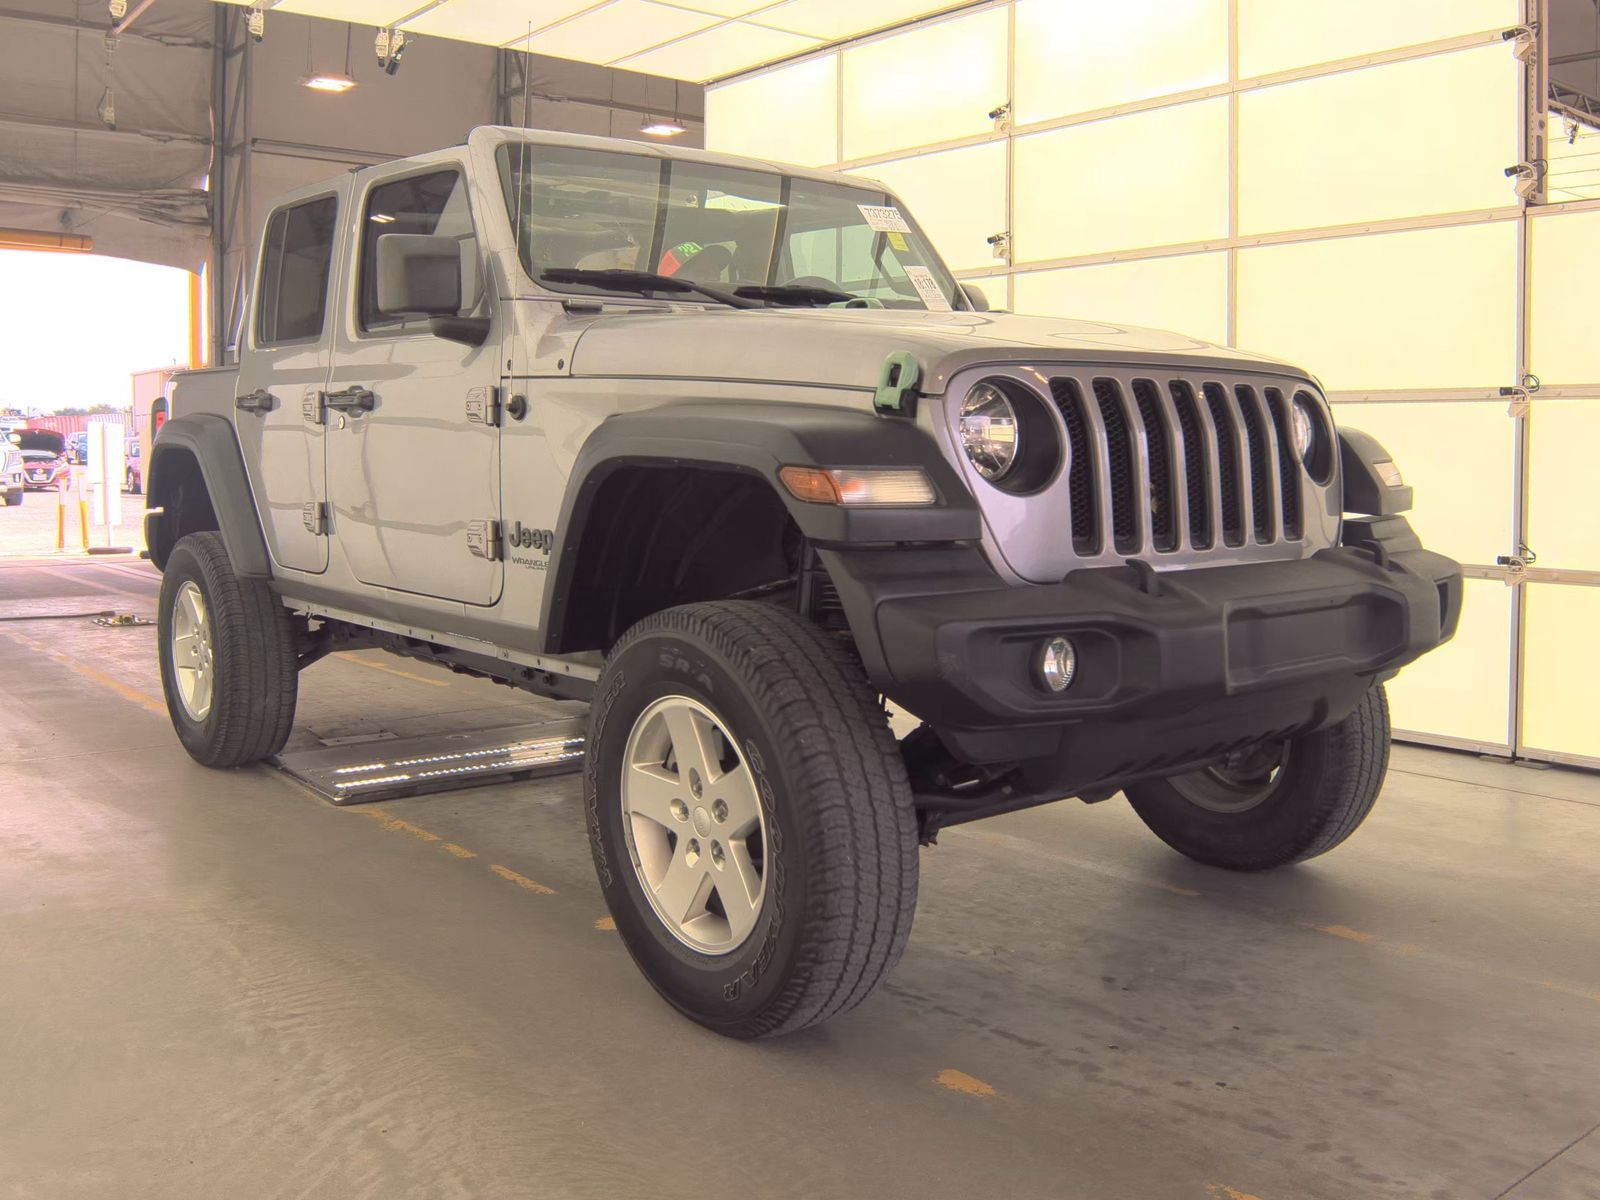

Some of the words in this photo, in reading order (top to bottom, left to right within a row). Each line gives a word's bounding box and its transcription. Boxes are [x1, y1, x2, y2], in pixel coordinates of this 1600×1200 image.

[509, 520, 554, 556] Jeep
[512, 555, 550, 567] WRANGLE
[722, 737, 786, 1002] GOODYEAR
